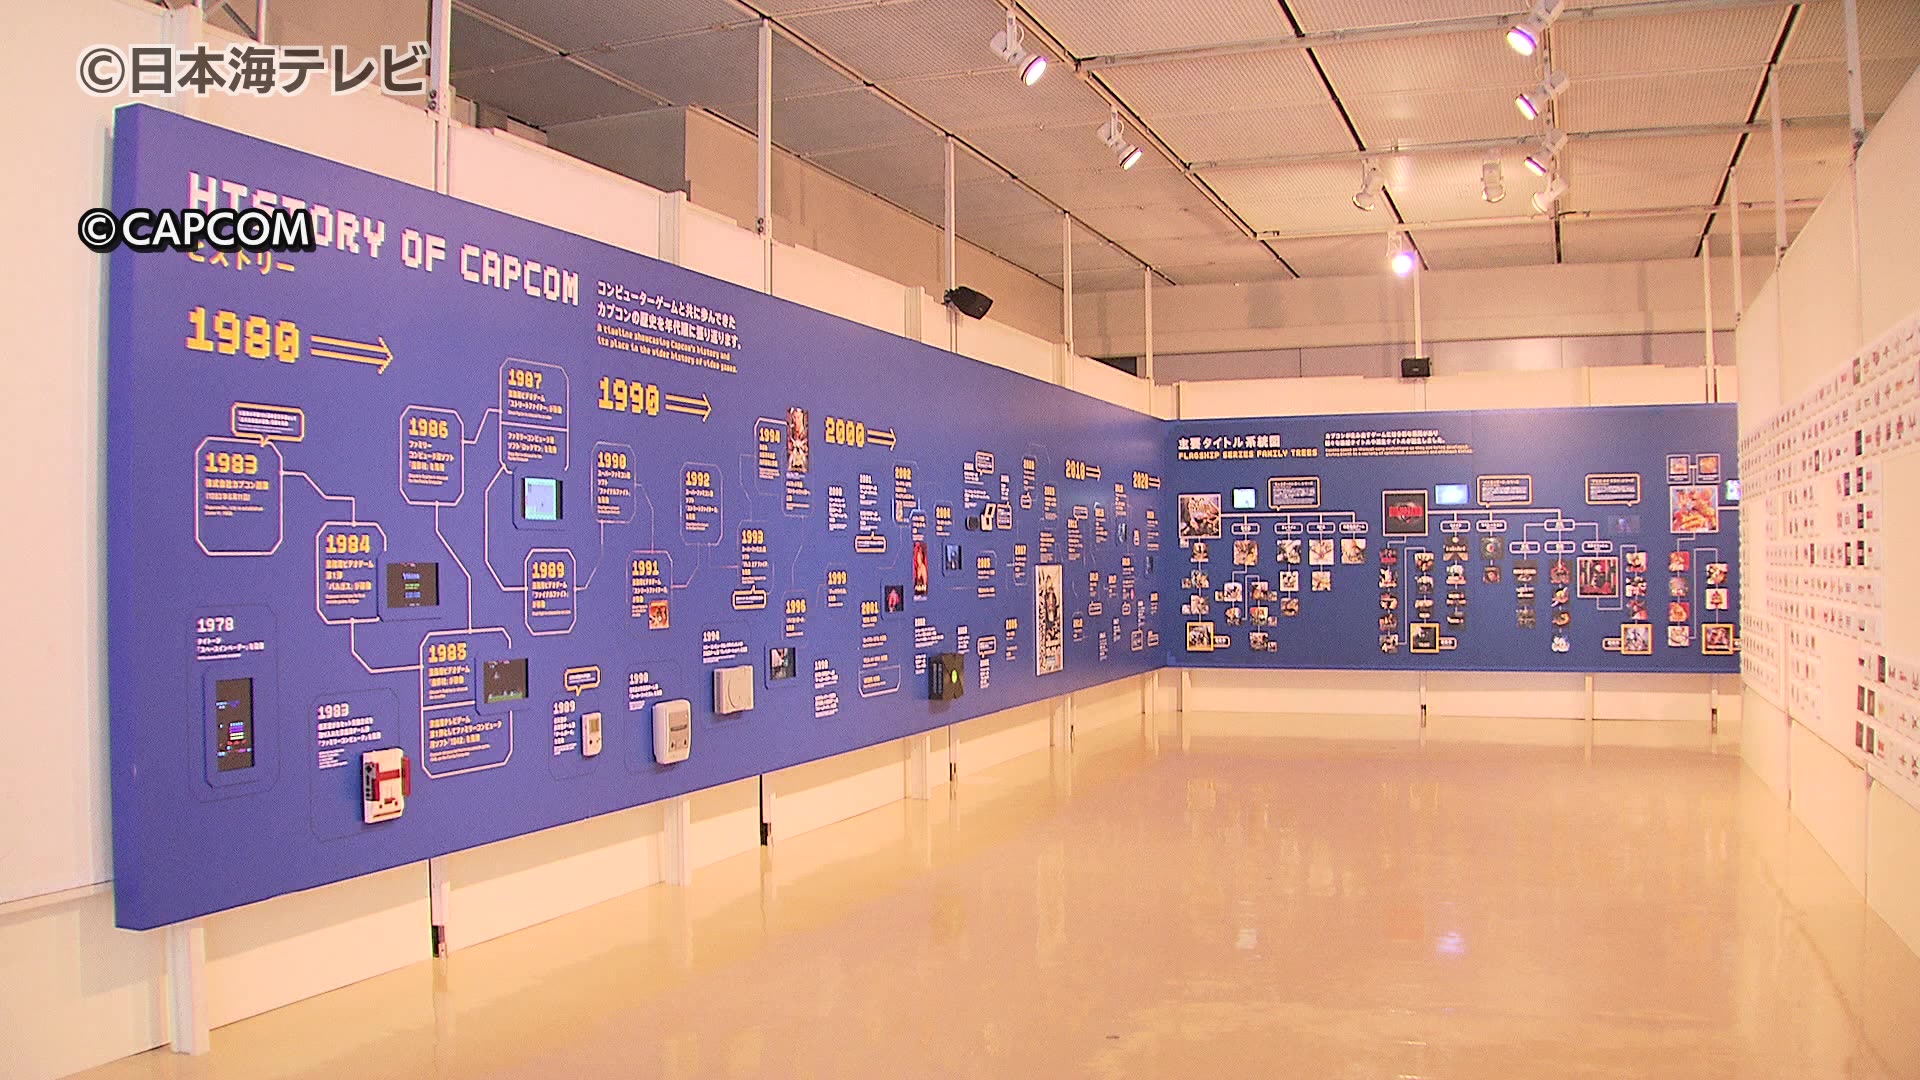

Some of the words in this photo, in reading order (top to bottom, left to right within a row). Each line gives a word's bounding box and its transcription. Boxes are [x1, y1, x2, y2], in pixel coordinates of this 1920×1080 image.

[401, 229, 446, 272] OF
[459, 242, 580, 308] CAPCOM
[186, 306, 300, 363] 1980
[507, 368, 542, 389] 1987
[598, 376, 659, 416] 1990
[408, 417, 449, 439] 1986
[825, 416, 866, 448] 2000
[204, 451, 258, 474] 1983
[1178, 451, 1220, 460] FLAGSHIP
[1222, 450, 1254, 459] SERIES
[1257, 448, 1288, 458] FAMILY
[1291, 448, 1318, 457] TREES
[685, 471, 710, 488] 1992
[1065, 459, 1086, 480] 2010
[325, 534, 371, 554] 1984
[532, 561, 566, 579] 1989
[632, 560, 659, 576] 1991
[197, 617, 234, 633] 1978
[428, 642, 467, 663] 1985
[317, 703, 350, 720] 1983
